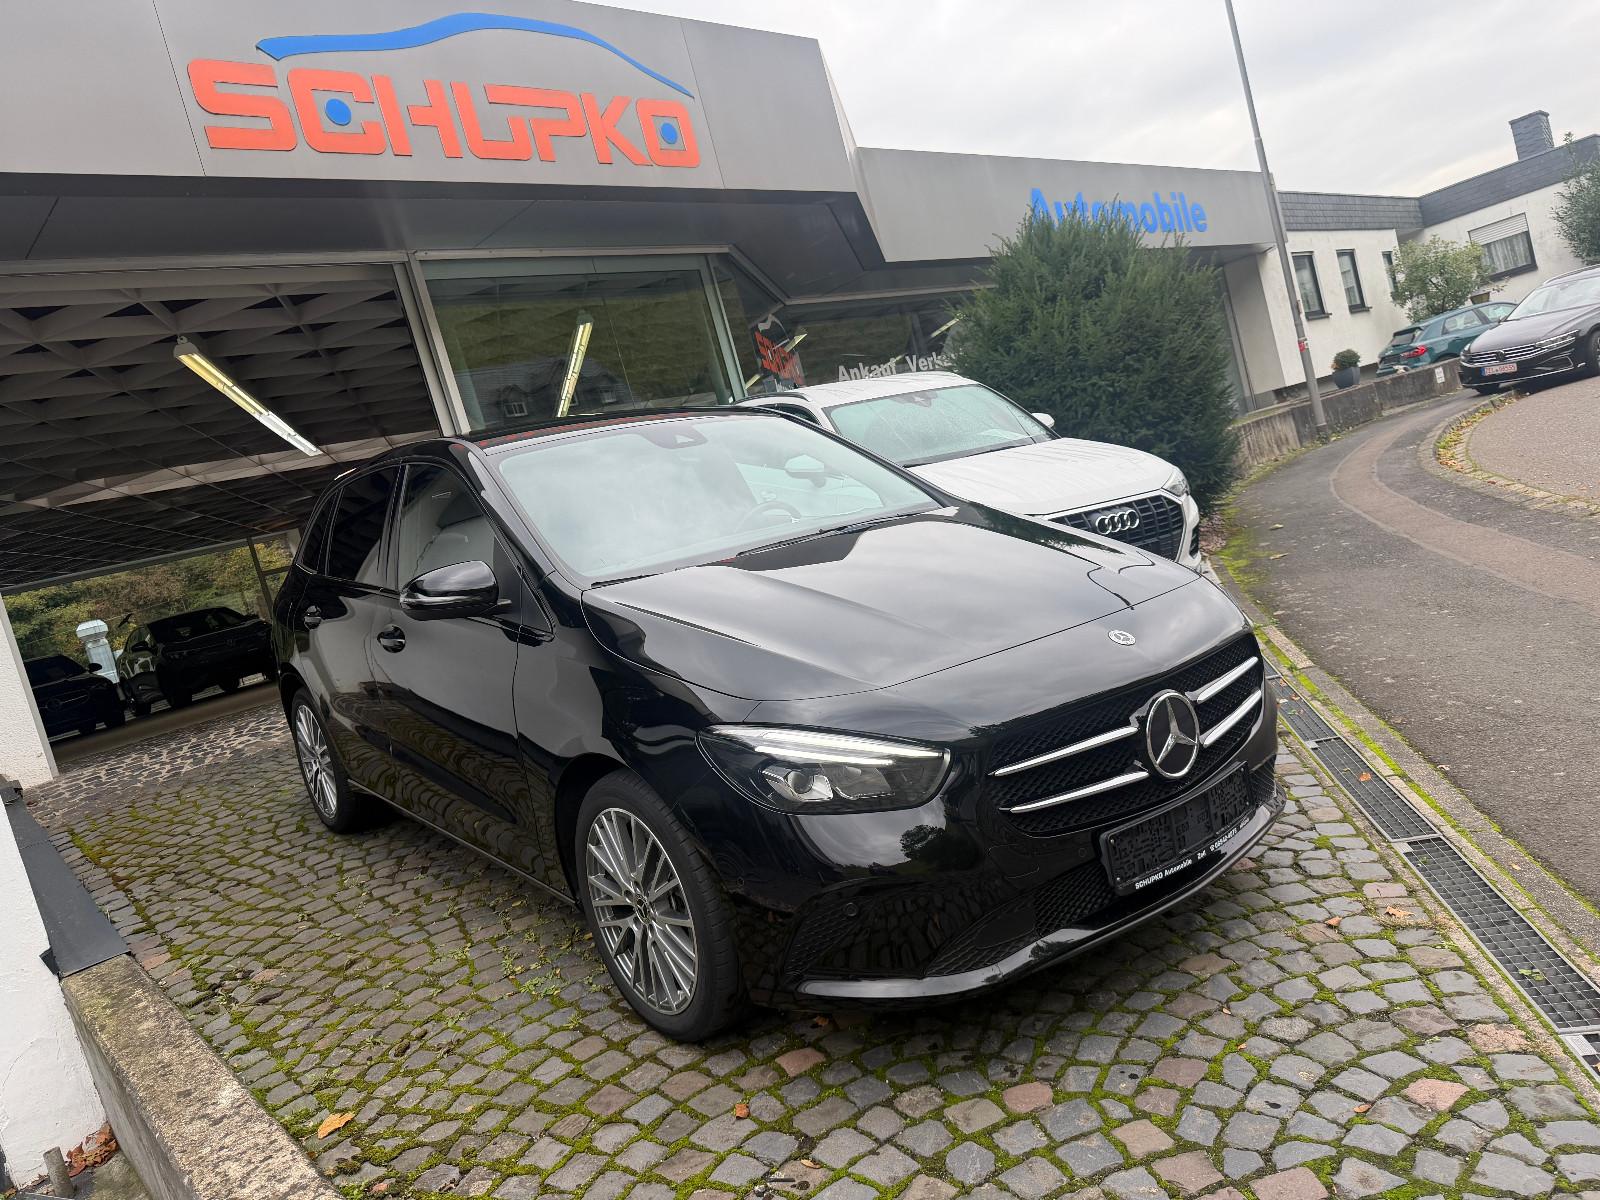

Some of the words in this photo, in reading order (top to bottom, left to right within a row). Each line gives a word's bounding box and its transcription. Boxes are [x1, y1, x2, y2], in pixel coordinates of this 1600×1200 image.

[187, 58, 700, 168] SCHUPKO
[838, 358, 897, 382] Ankauf
[905, 352, 957, 372] Verk
[1135, 872, 1163, 889] SCHUPKO
